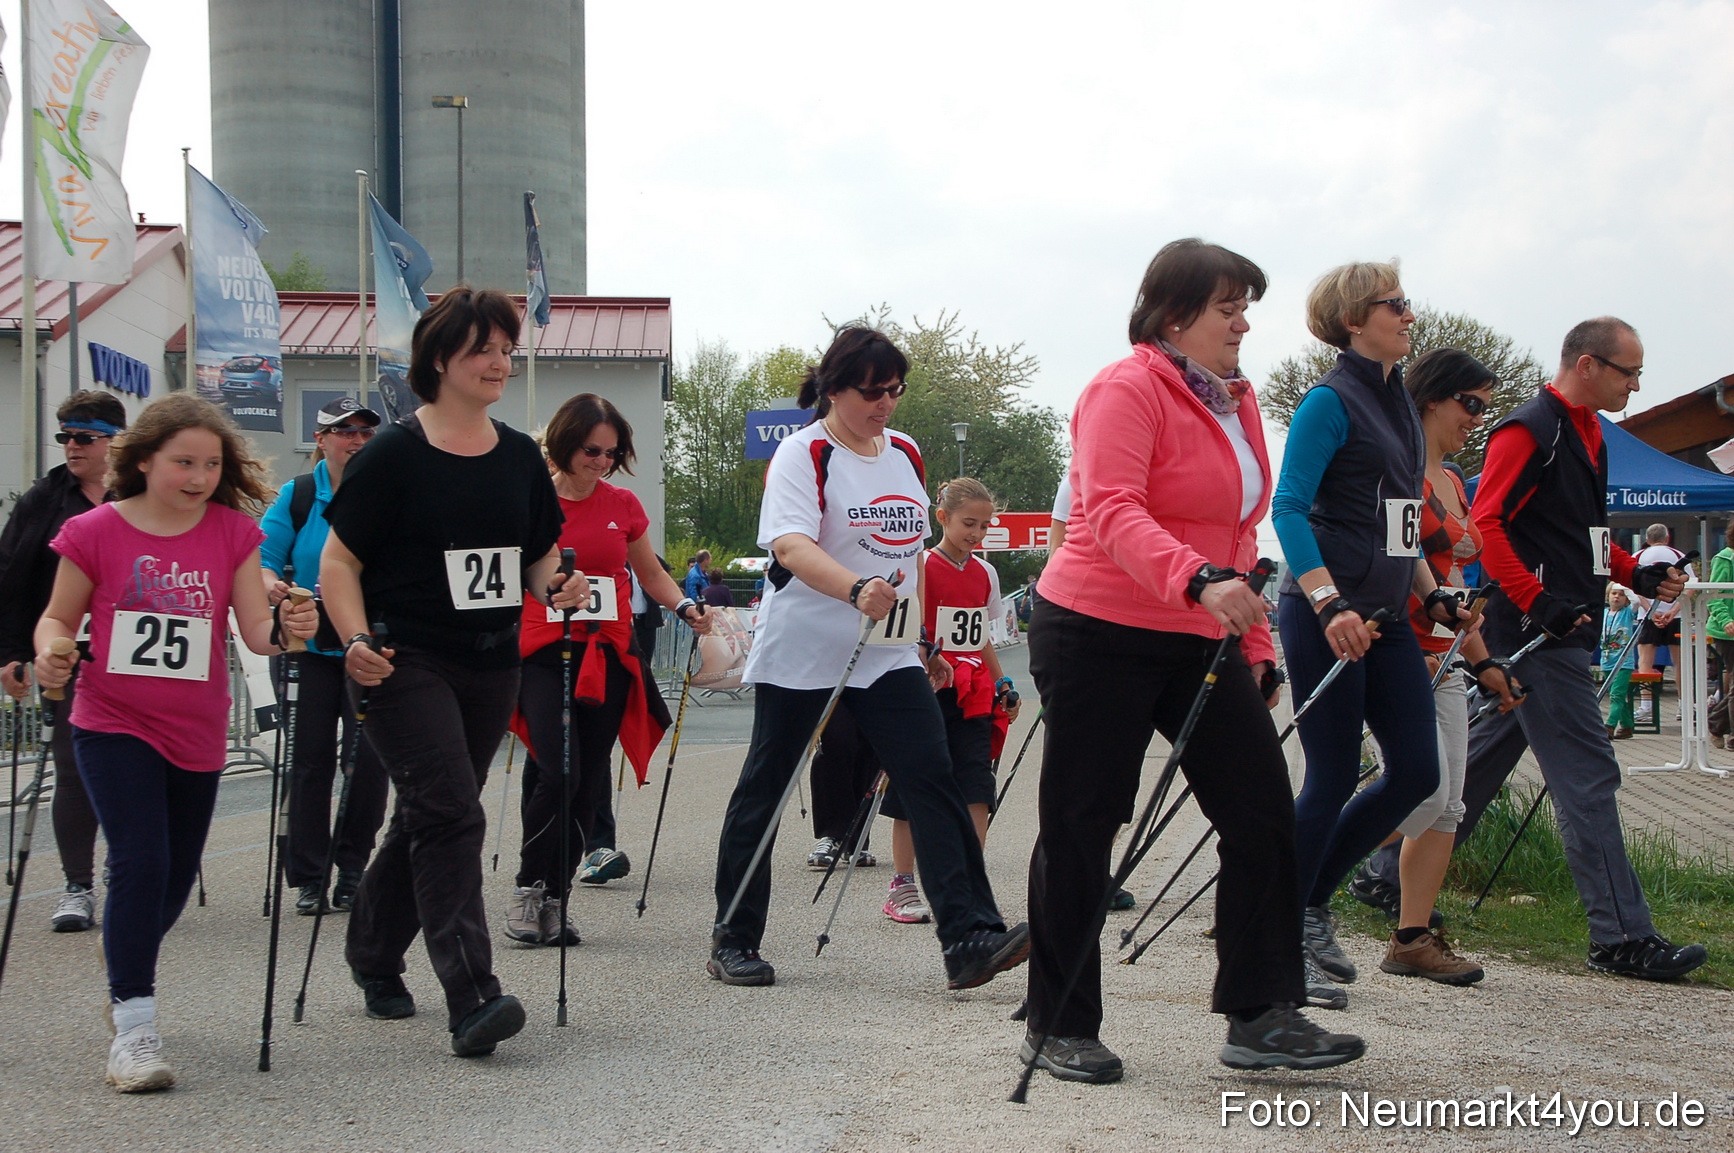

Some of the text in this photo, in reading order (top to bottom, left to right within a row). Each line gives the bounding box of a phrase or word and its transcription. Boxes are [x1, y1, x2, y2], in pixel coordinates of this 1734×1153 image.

[90, 342, 150, 398] VOLVO
[847, 506, 915, 519] GERHART
[1619, 488, 1687, 507] Tagblatt
[881, 519, 924, 533] JÄNIG
[857, 538, 871, 551] Das
[870, 547, 902, 560] sportliche
[465, 552, 506, 601] 24
[884, 597, 910, 639] 11
[951, 610, 983, 647] 36
[131, 615, 189, 670] 25
